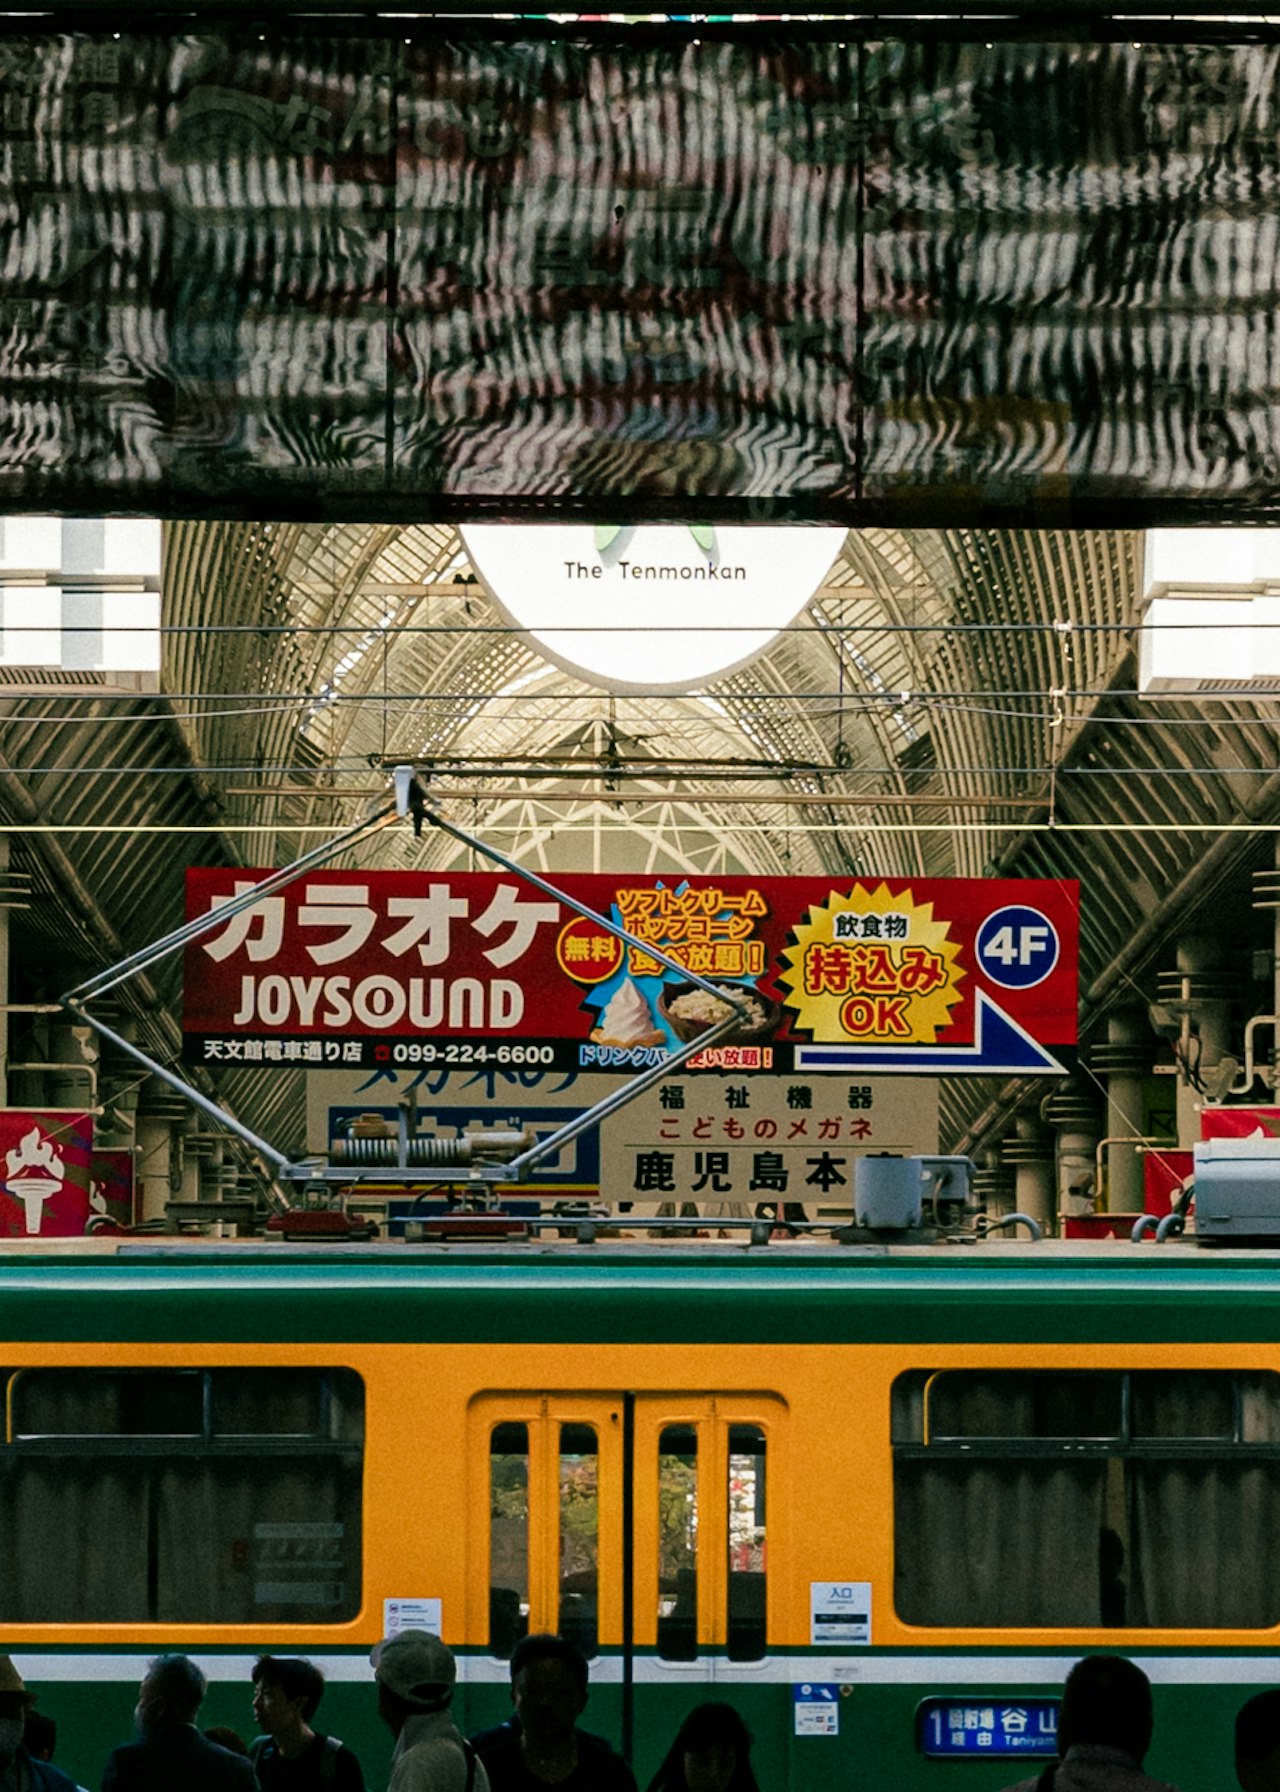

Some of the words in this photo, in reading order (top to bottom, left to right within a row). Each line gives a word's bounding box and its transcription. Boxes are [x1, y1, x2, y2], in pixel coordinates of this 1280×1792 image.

[564, 562, 603, 579] The
[619, 562, 746, 579] Tenmonkan
[616, 889, 767, 916] ソフトクリーム
[202, 881, 560, 969] カラオケ
[835, 914, 908, 939] 飲食物
[564, 935, 617, 963] 無料
[983, 927, 1049, 966] 4F
[804, 945, 948, 993] 持込み
[233, 975, 524, 1029] JOYSOUND
[840, 1000, 911, 1036] OK
[203, 1040, 362, 1062] 天文館電車通り店
[393, 1044, 554, 1064] 099-224-6600
[660, 1117, 874, 1141] こどものメガネ
[634, 1151, 906, 1192] 鹿児島本
[929, 1710, 942, 1746] 1
[1005, 1734, 1057, 1747] Taniyam
